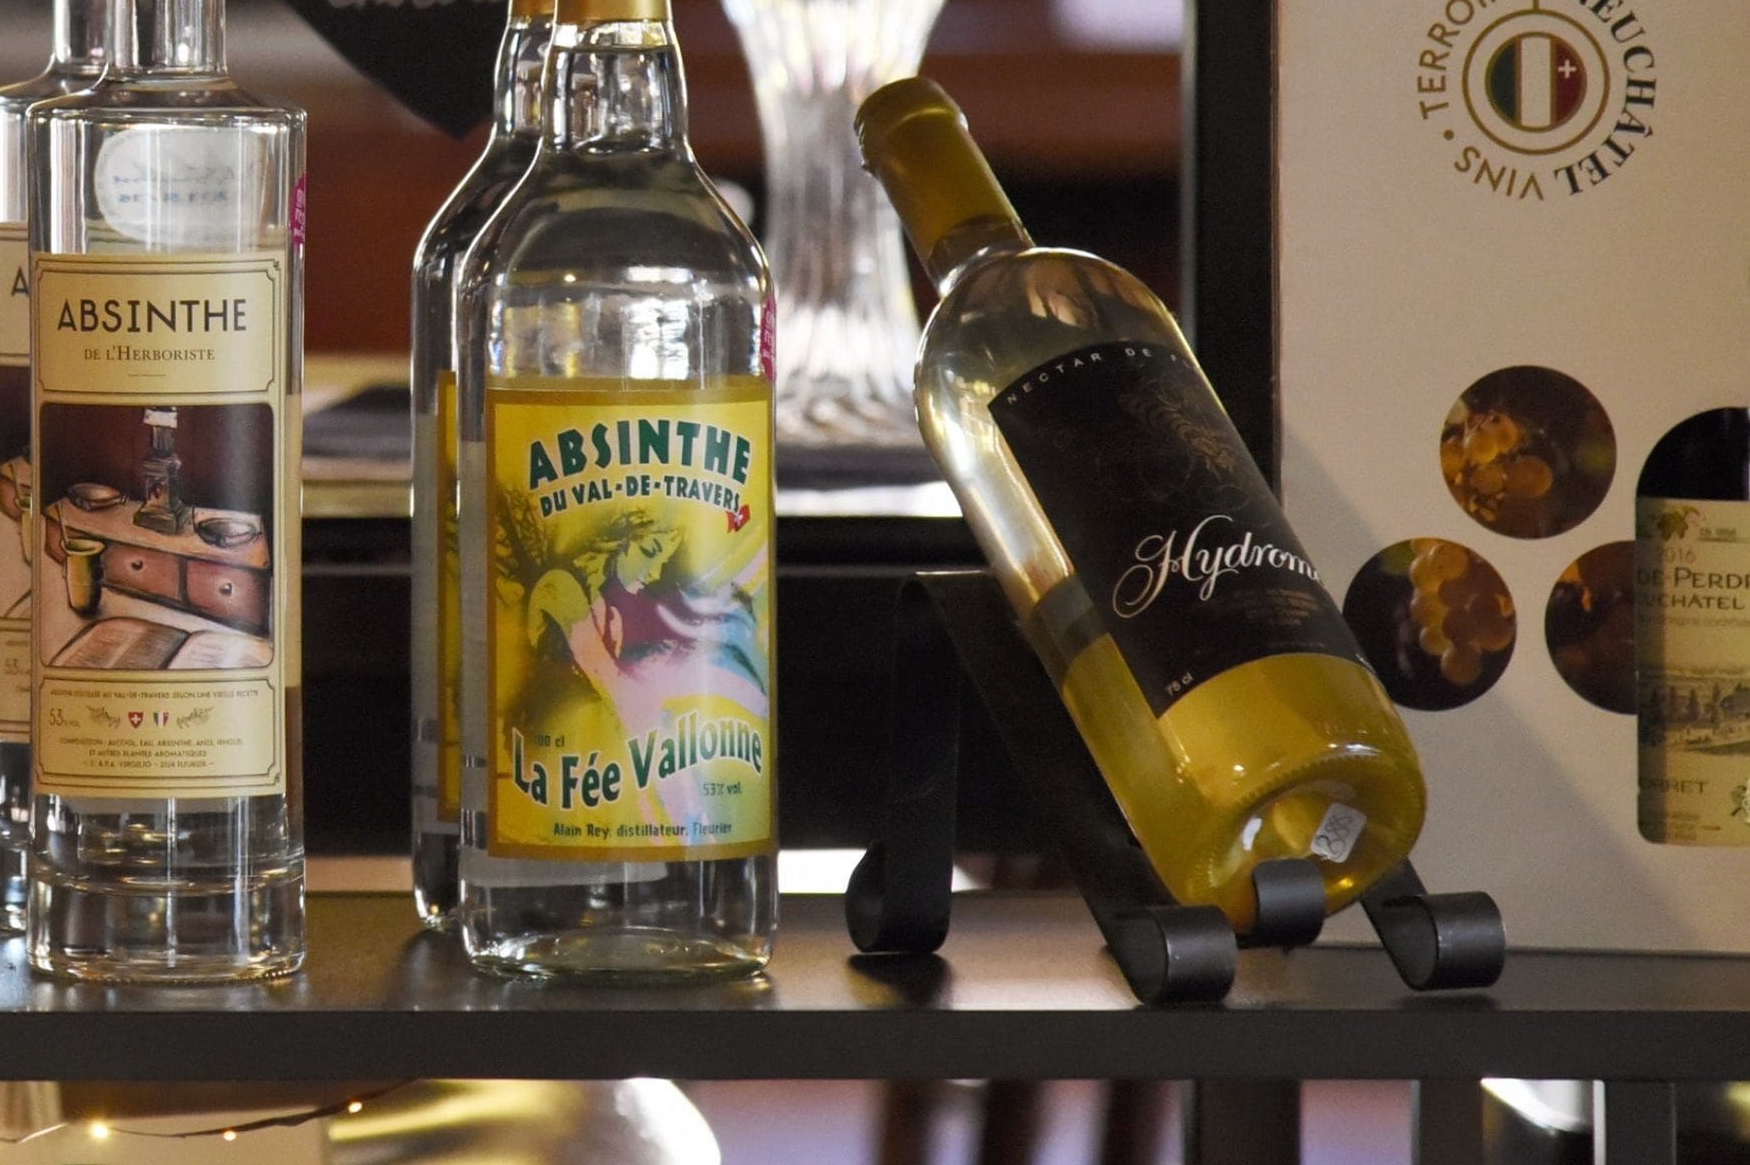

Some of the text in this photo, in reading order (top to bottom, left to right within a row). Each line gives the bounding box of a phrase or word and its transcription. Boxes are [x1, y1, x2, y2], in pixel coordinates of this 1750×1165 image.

[1453, 145, 1544, 201] VINS
[57, 298, 246, 333] ABSINTHE
[83, 348, 101, 361] DE
[1006, 347, 1152, 405] NECTAR DE
[528, 417, 751, 491] ABSINTHE
[538, 474, 740, 518] DU VAL-DE-TRAVERS
[512, 709, 763, 810] La Fée Vallonne
[553, 822, 582, 837] Alain
[693, 822, 733, 837] Fleurier
